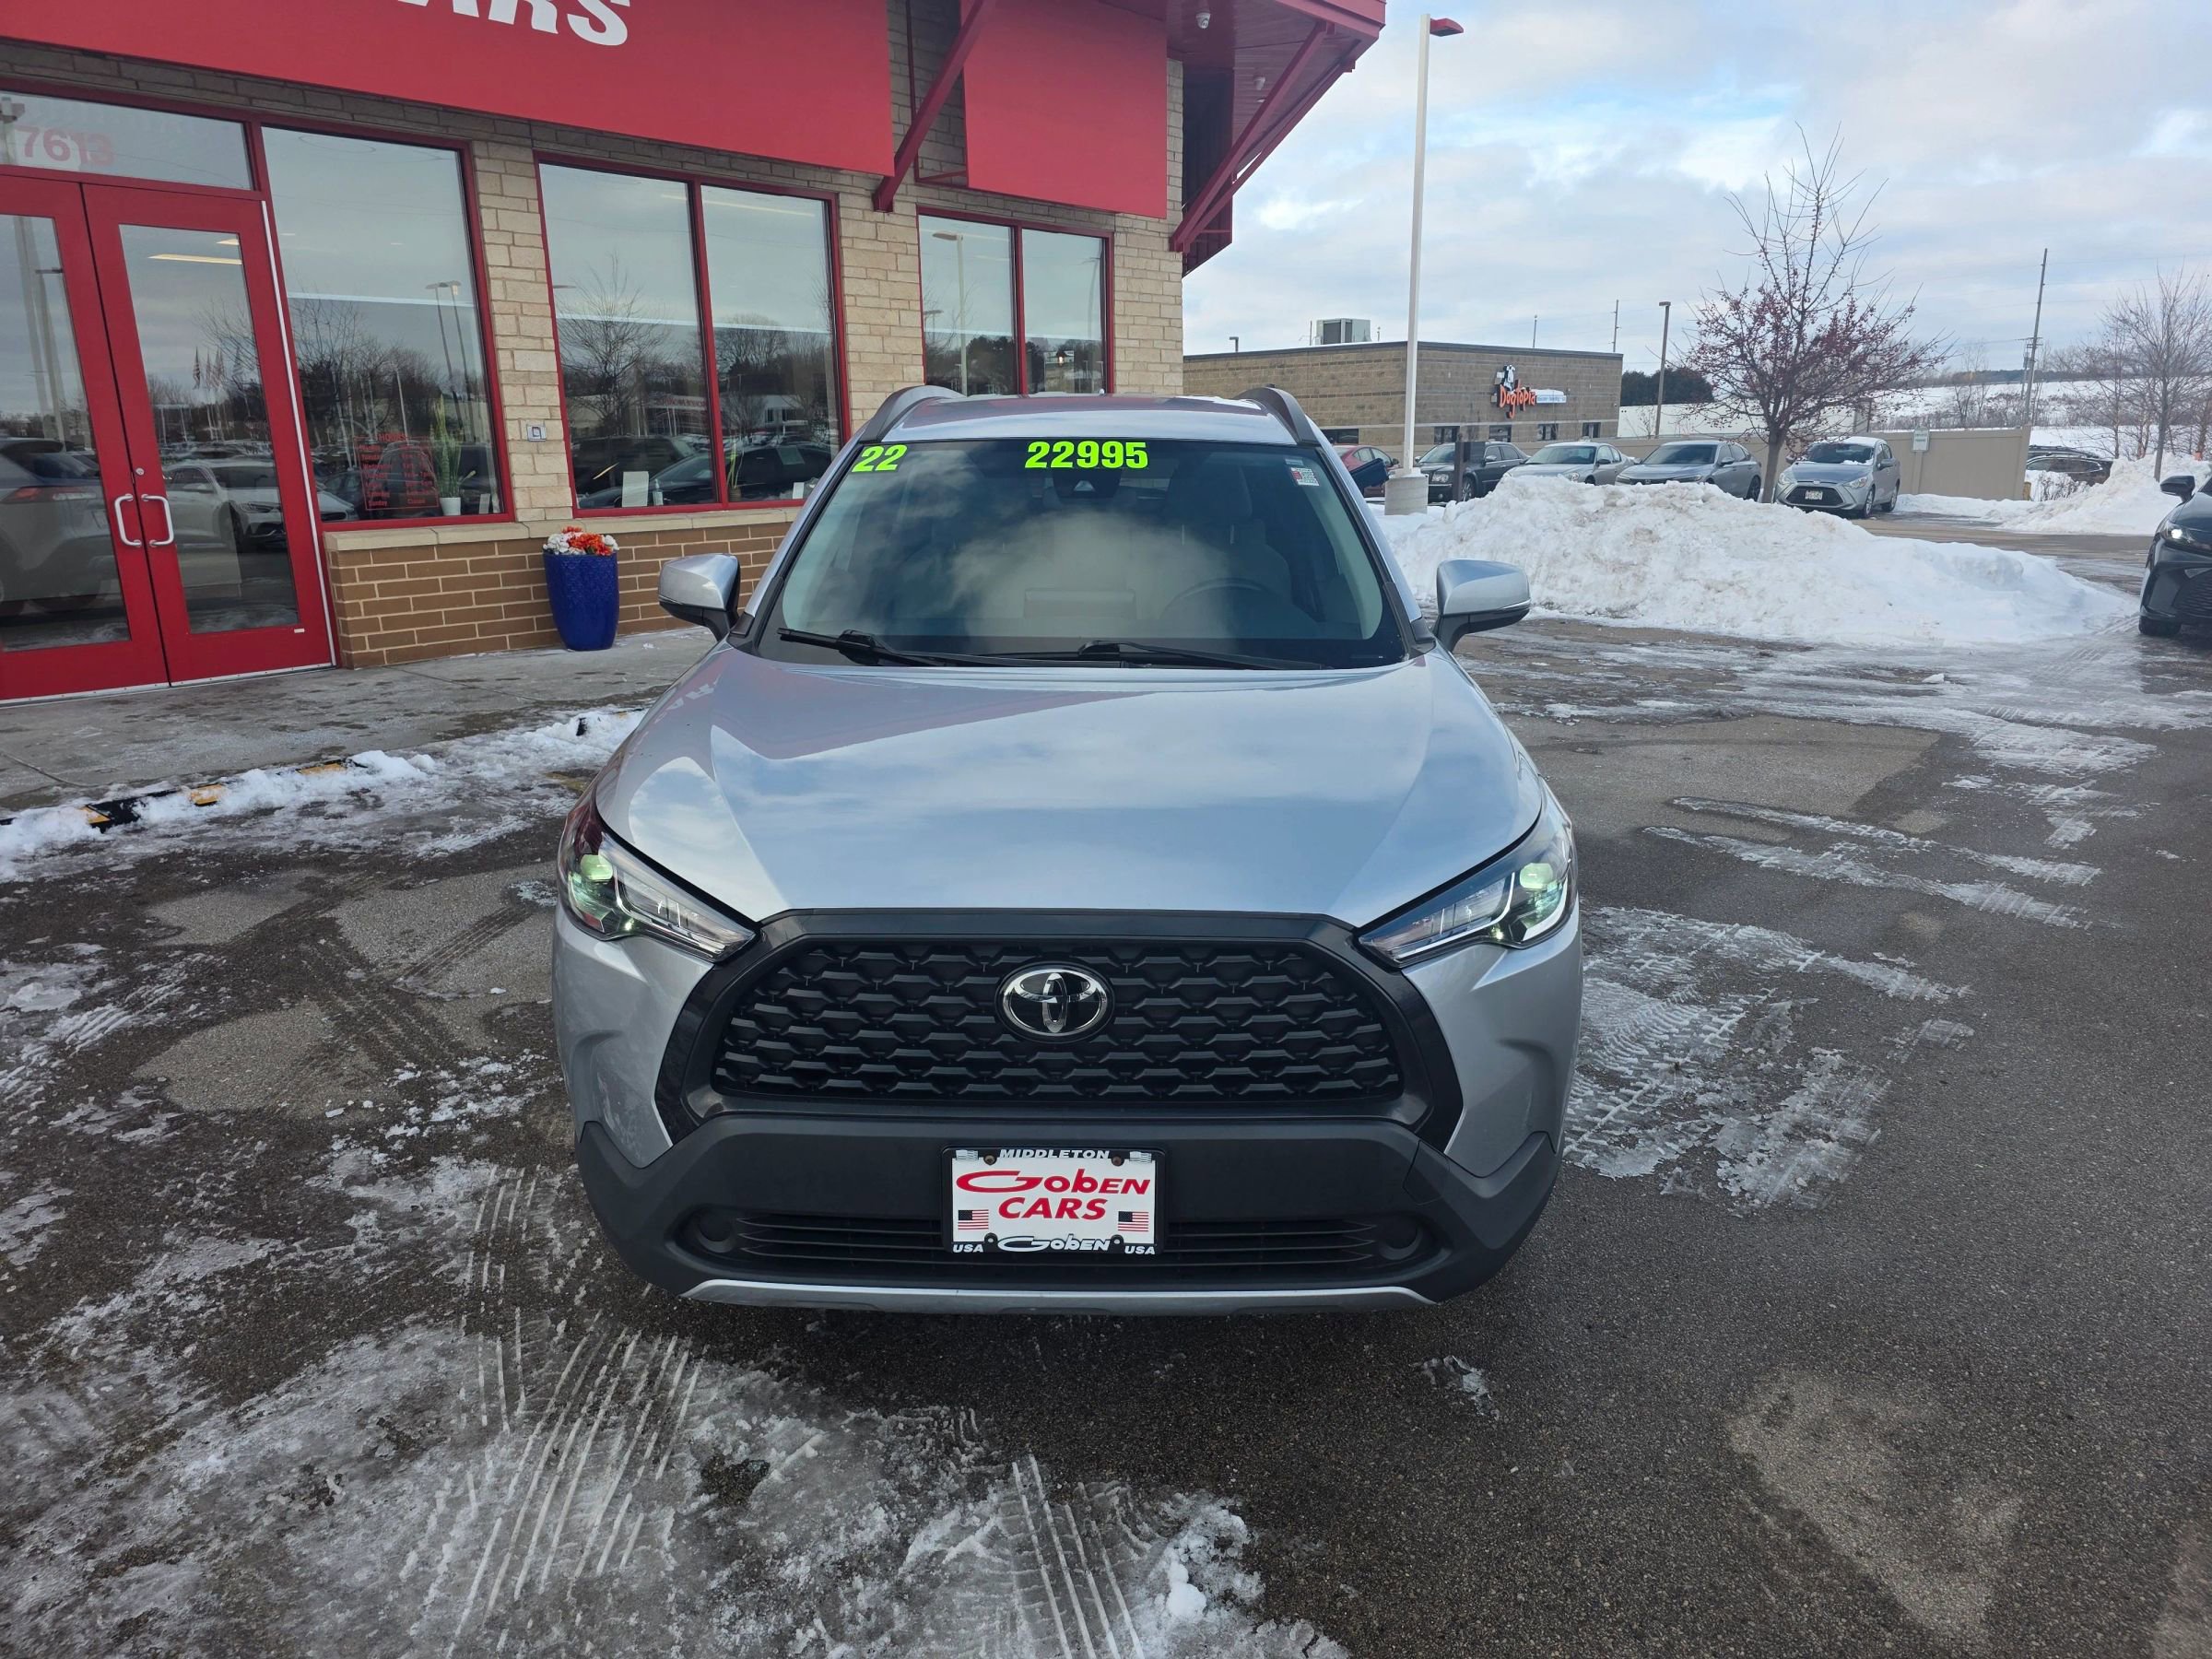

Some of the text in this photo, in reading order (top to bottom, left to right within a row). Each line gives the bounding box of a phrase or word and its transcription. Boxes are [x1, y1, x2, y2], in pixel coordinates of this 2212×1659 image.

[16, 125, 116, 165] 7613
[1500, 379, 1535, 418] Dogtopia
[852, 444, 907, 472] 22
[1024, 441, 1148, 469] 22995
[1000, 1149, 1110, 1159] MIDDLETON
[998, 1197, 1108, 1220] CARS
[953, 1244, 983, 1253] USA
[1124, 1246, 1156, 1254] USA
